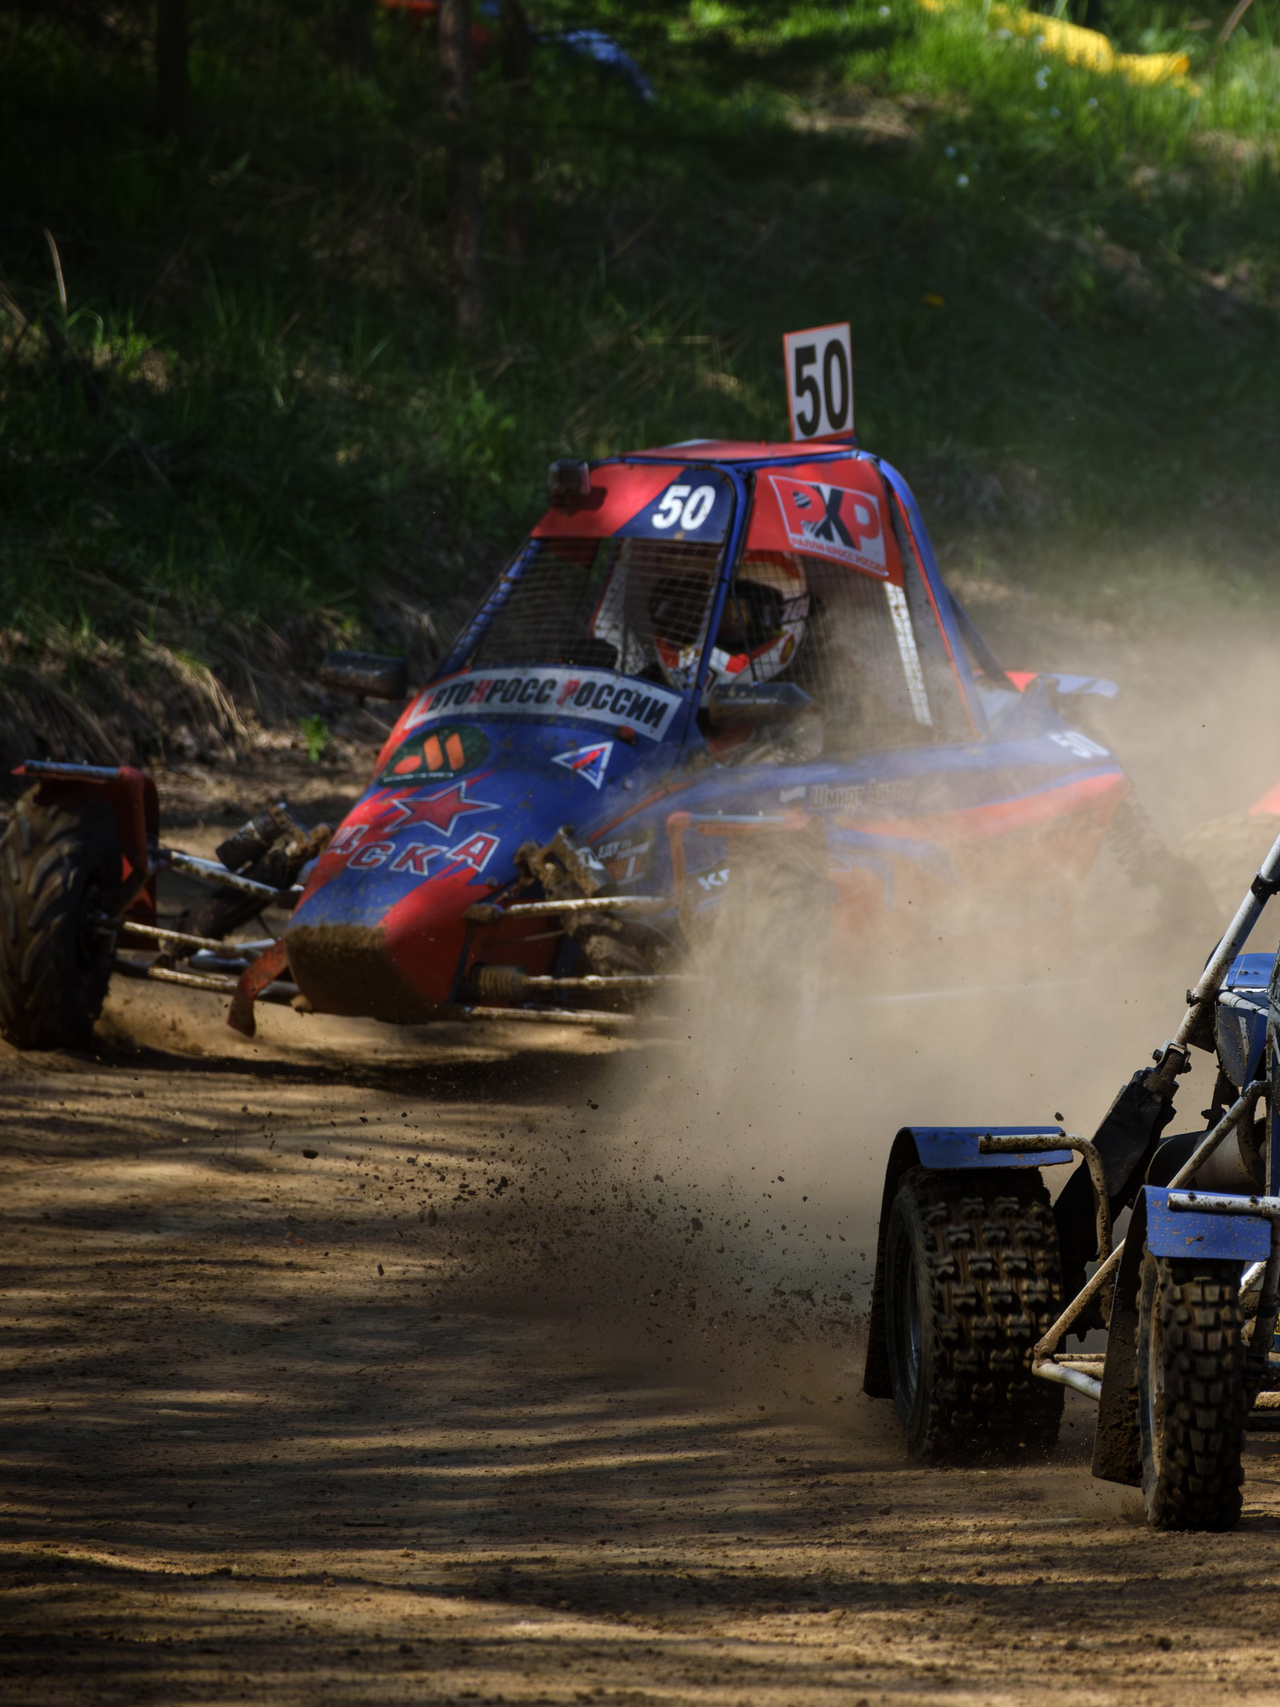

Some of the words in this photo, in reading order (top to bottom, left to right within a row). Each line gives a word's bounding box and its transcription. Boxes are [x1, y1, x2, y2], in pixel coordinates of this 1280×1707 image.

[794, 338, 850, 437] 50
[651, 485, 716, 531] 50
[557, 679, 670, 729] РОССИИ
[326, 824, 501, 876] ЦСКА
